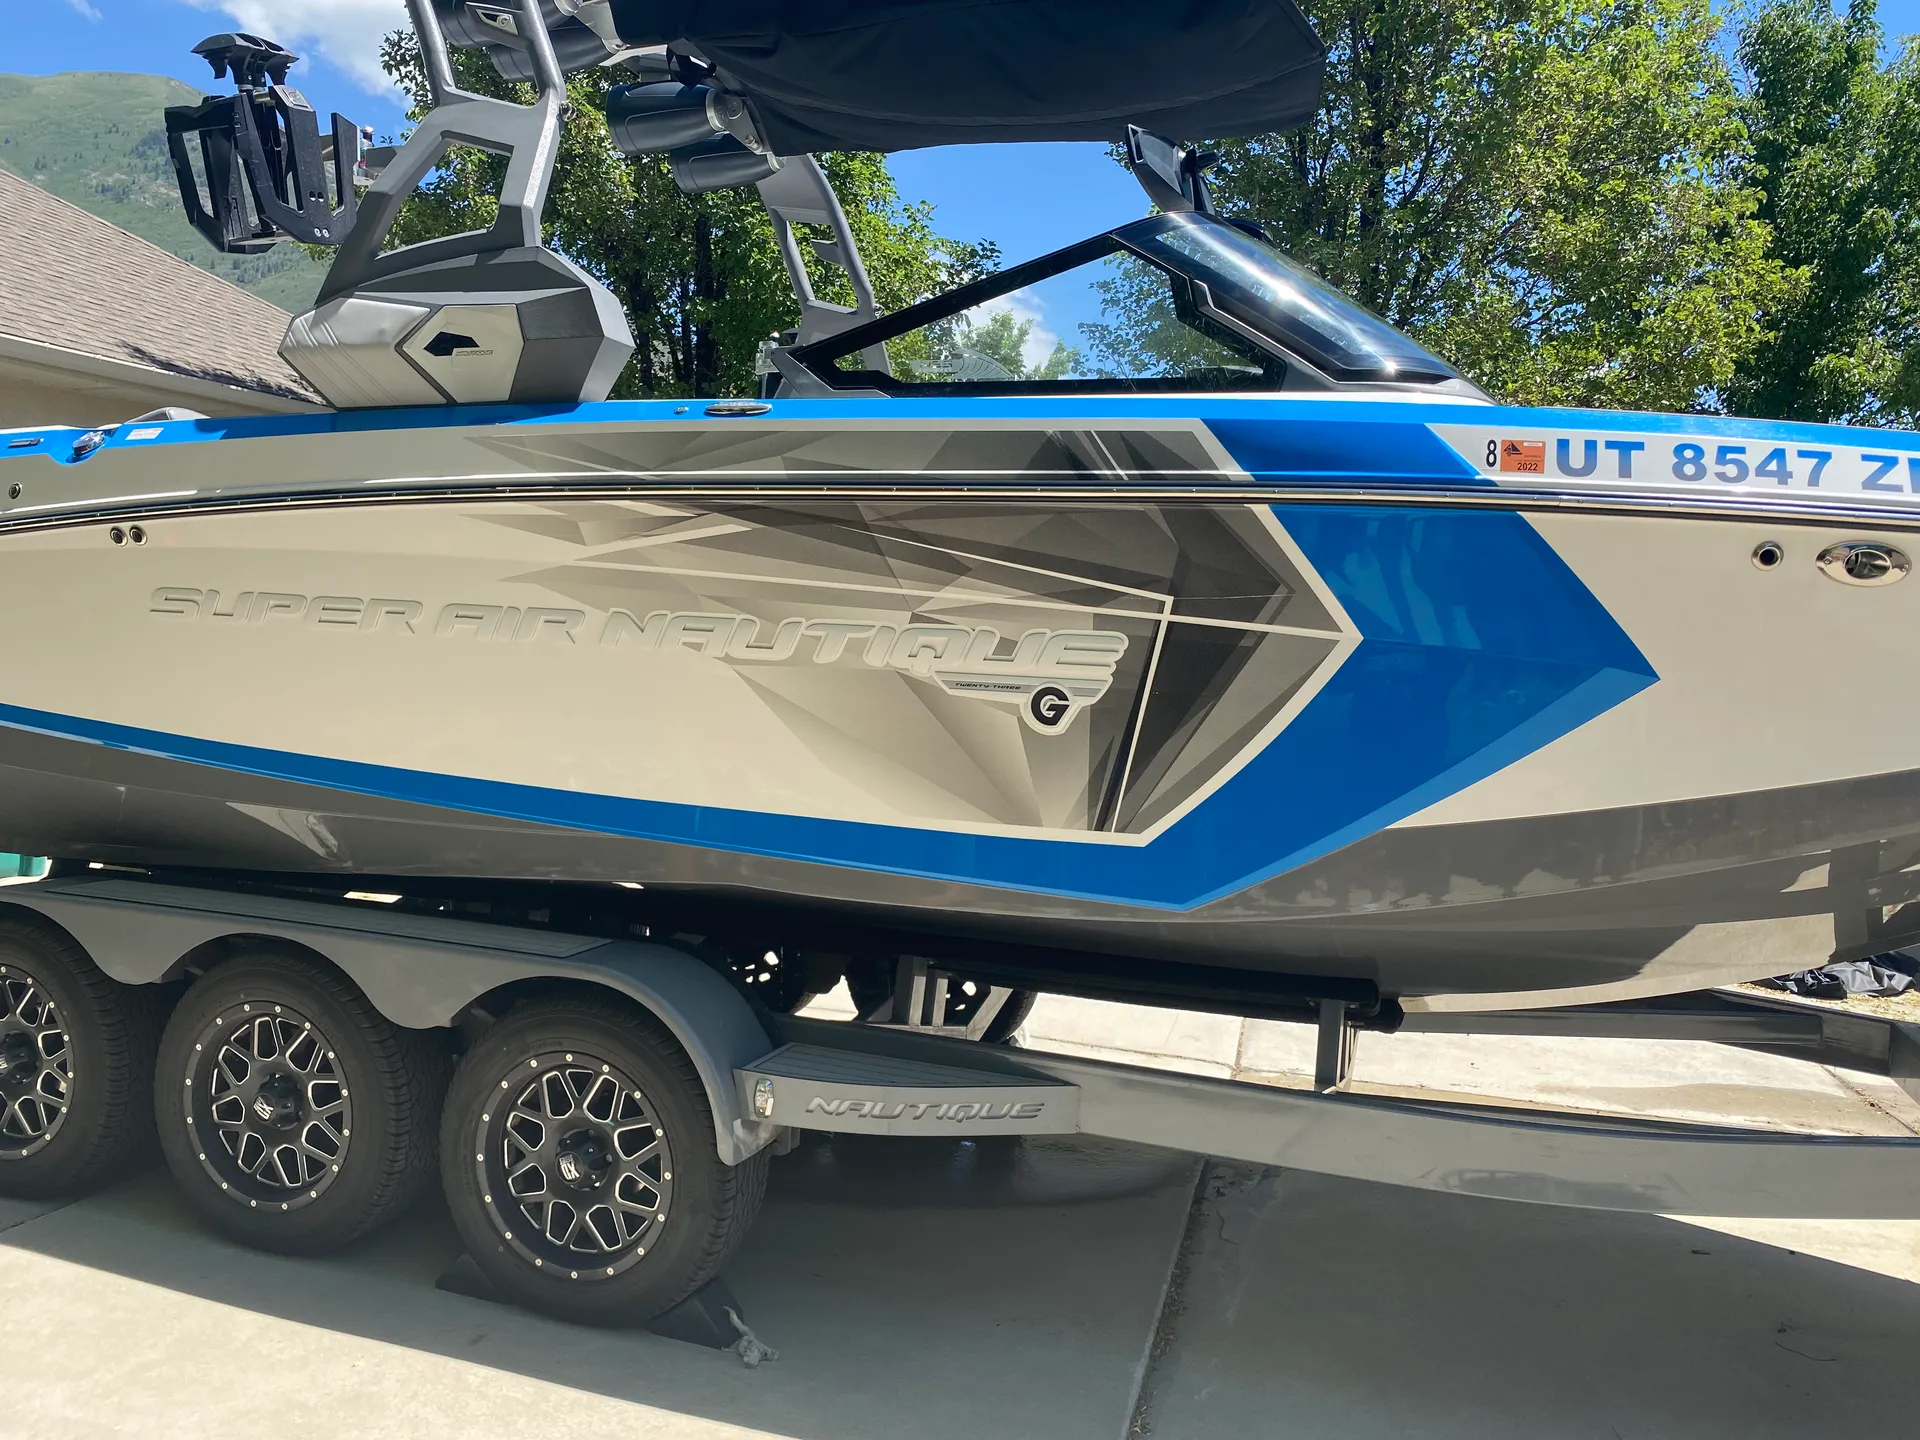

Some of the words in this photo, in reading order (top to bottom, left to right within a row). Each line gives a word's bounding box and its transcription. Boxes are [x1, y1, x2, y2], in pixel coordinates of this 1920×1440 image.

[1486, 439, 1497, 468] 8
[1517, 462, 1538, 471] 2022
[1556, 438, 1645, 479] UT
[1671, 443, 1833, 488] 8547
[149, 586, 424, 634] SUPER
[436, 602, 586, 645] AIR
[600, 608, 1127, 676] NAUTIQUE
[804, 1095, 1045, 1123] NAUTIQUE
